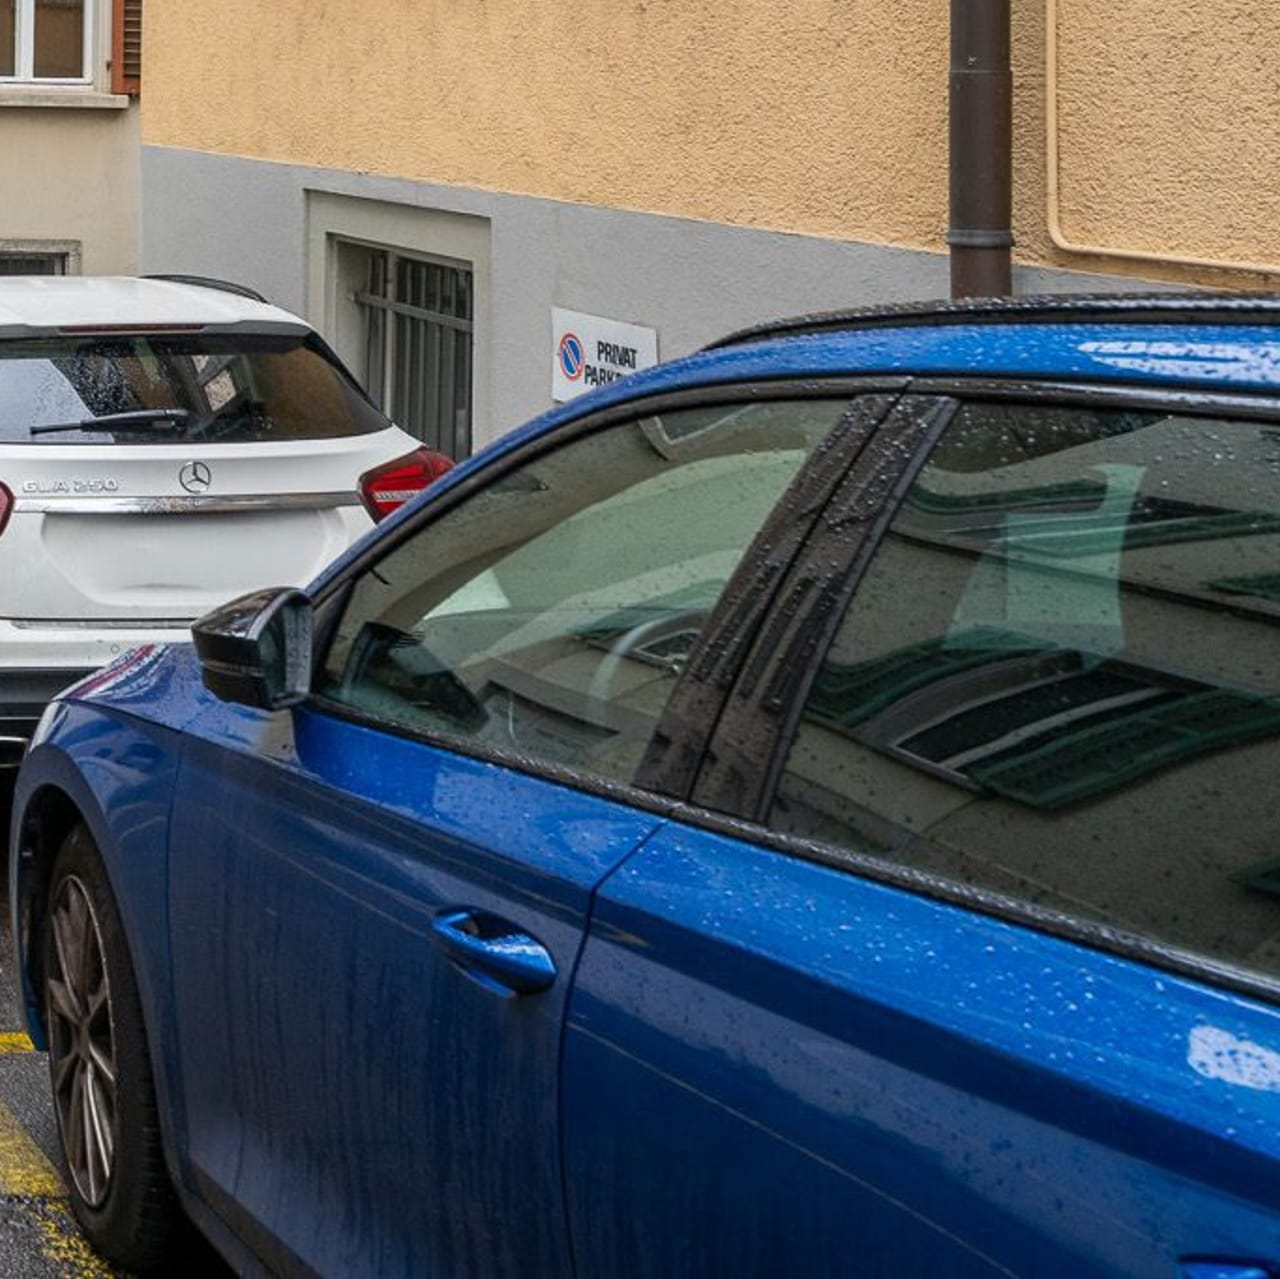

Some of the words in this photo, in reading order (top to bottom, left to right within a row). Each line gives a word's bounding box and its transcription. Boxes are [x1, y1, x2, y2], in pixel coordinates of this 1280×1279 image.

[597, 340, 638, 369] PRIVAT
[23, 479, 70, 494] GLA
[73, 477, 120, 493] 250
